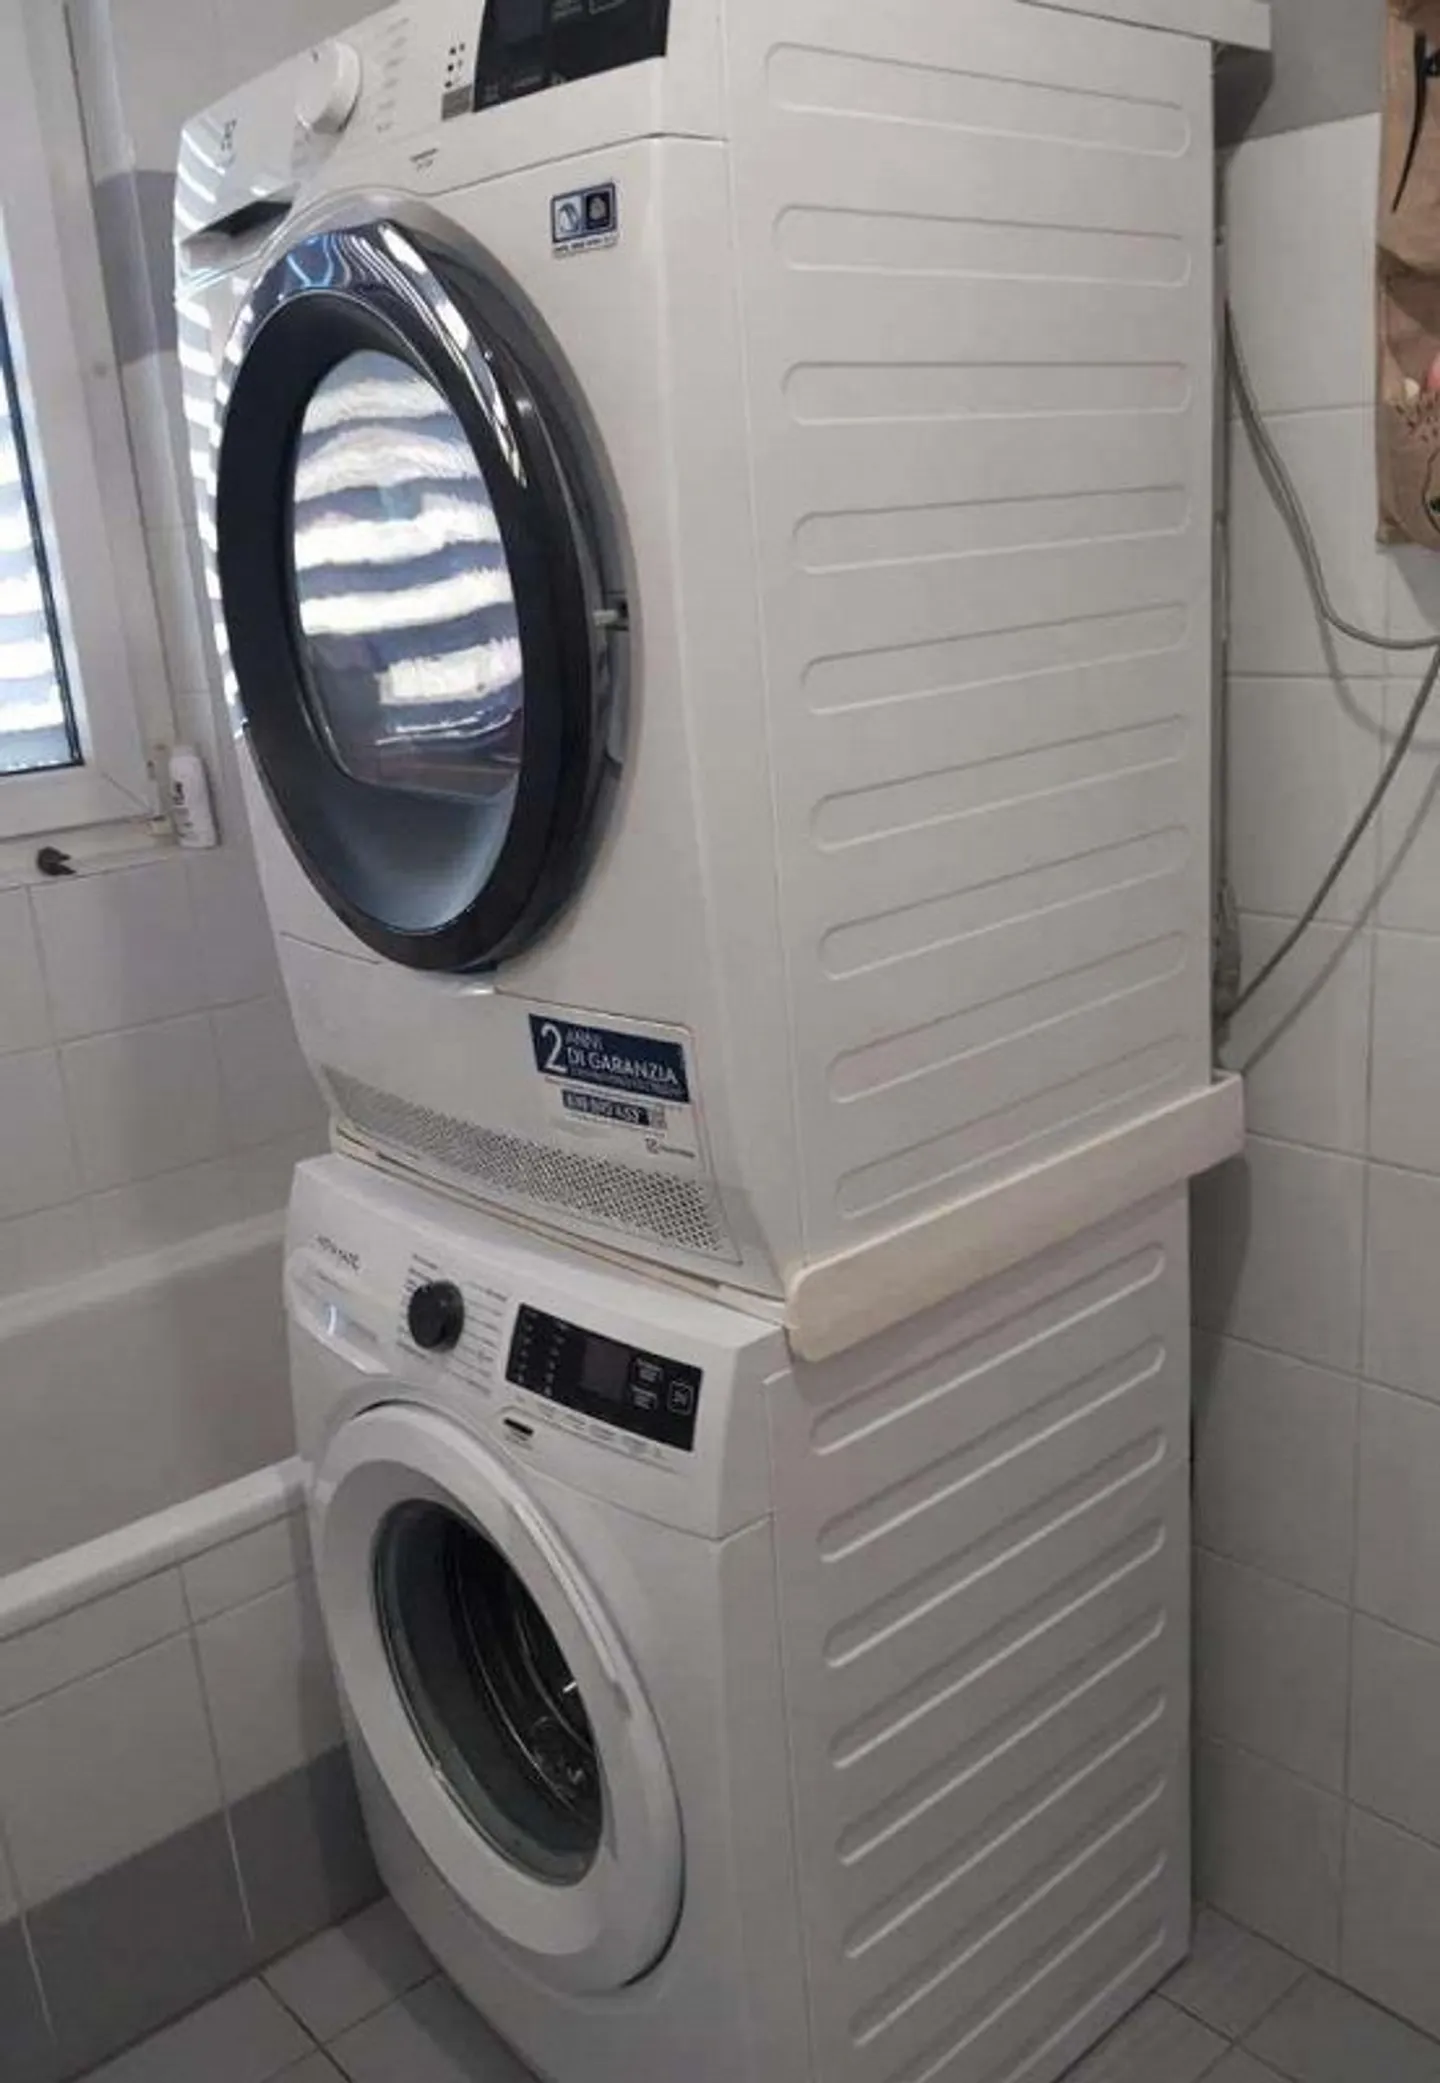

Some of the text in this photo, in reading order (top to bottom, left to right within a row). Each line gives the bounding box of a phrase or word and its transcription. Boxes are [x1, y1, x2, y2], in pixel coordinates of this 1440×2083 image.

[540, 1022, 567, 1072] 2
[567, 1046, 586, 1067] DI
[587, 1051, 678, 1084] GARANZIA
